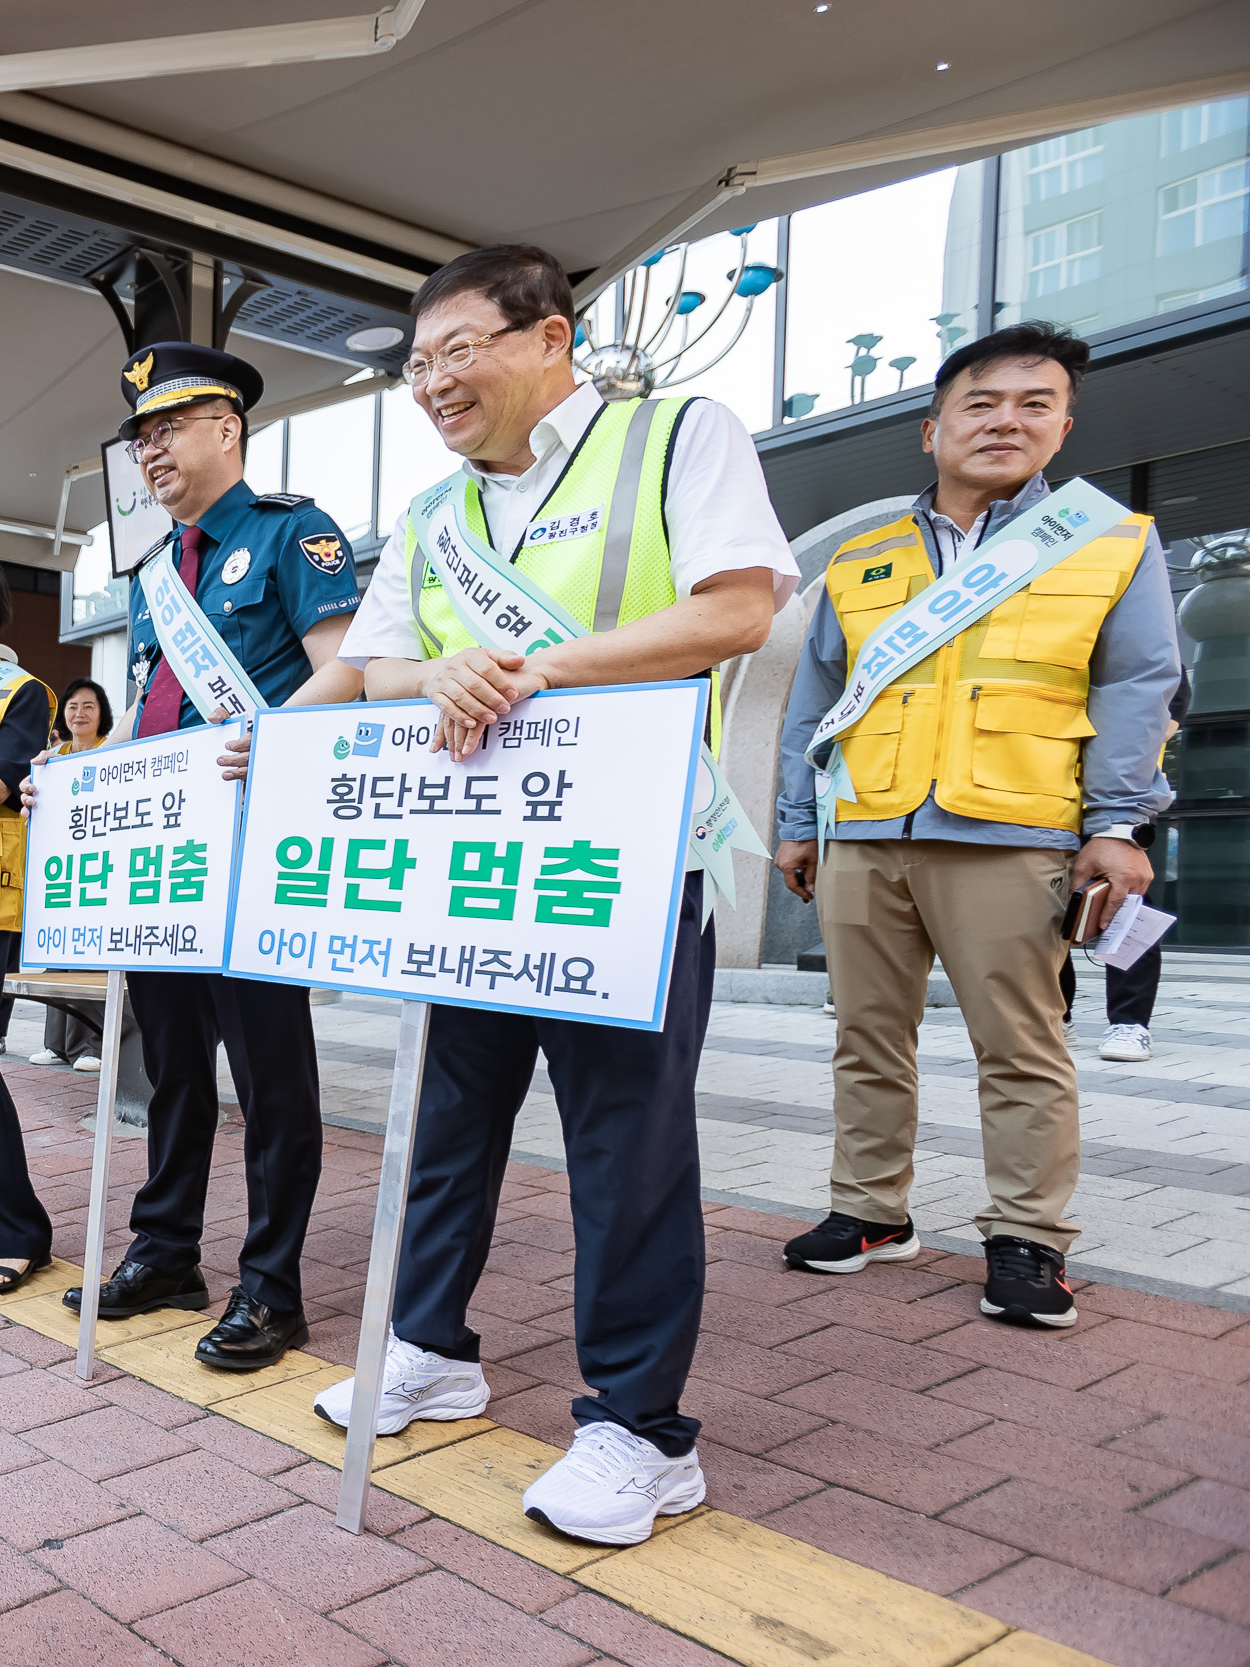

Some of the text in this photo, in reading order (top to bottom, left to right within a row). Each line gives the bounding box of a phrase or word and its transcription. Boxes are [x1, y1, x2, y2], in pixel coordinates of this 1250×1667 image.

[1030, 526, 1058, 549] 캠페인
[1041, 513, 1073, 543] 아이먼저
[436, 525, 533, 638] 횡단보도 앞
[927, 562, 1009, 623] 아이
[153, 576, 183, 625] 아이
[171, 625, 219, 679] 먼저
[860, 619, 928, 682] 먼저
[498, 716, 580, 749] 캠페인
[99, 749, 188, 786] 아이먼저 캠페인
[327, 770, 573, 821] 횡단보도 앞
[69, 789, 186, 840] 횡단보도 앞
[44, 839, 208, 909] 일단 멈춤
[274, 836, 622, 928] 일단 멈춤
[38, 924, 203, 956] 아이 먼저 보내주세요.
[258, 929, 609, 1000] 아이 먼저 보내주세요.
